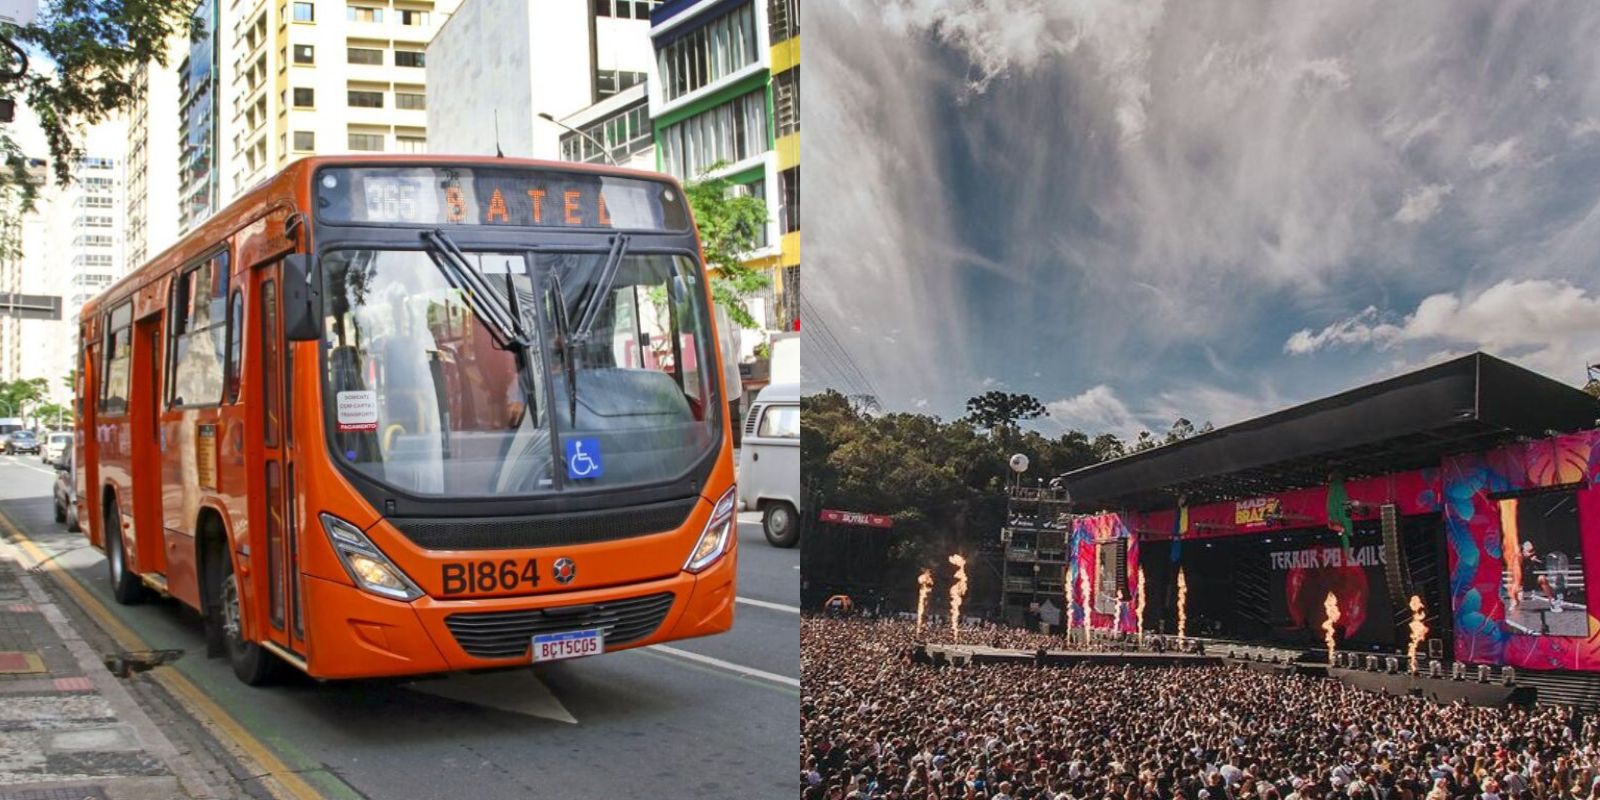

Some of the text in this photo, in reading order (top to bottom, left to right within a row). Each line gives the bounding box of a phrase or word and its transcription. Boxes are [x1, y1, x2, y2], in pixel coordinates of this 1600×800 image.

[446, 186, 614, 225] BATEL
[1270, 550, 1319, 570] TERROR
[441, 558, 541, 595] BI864
[542, 638, 597, 657] BCT5C05
